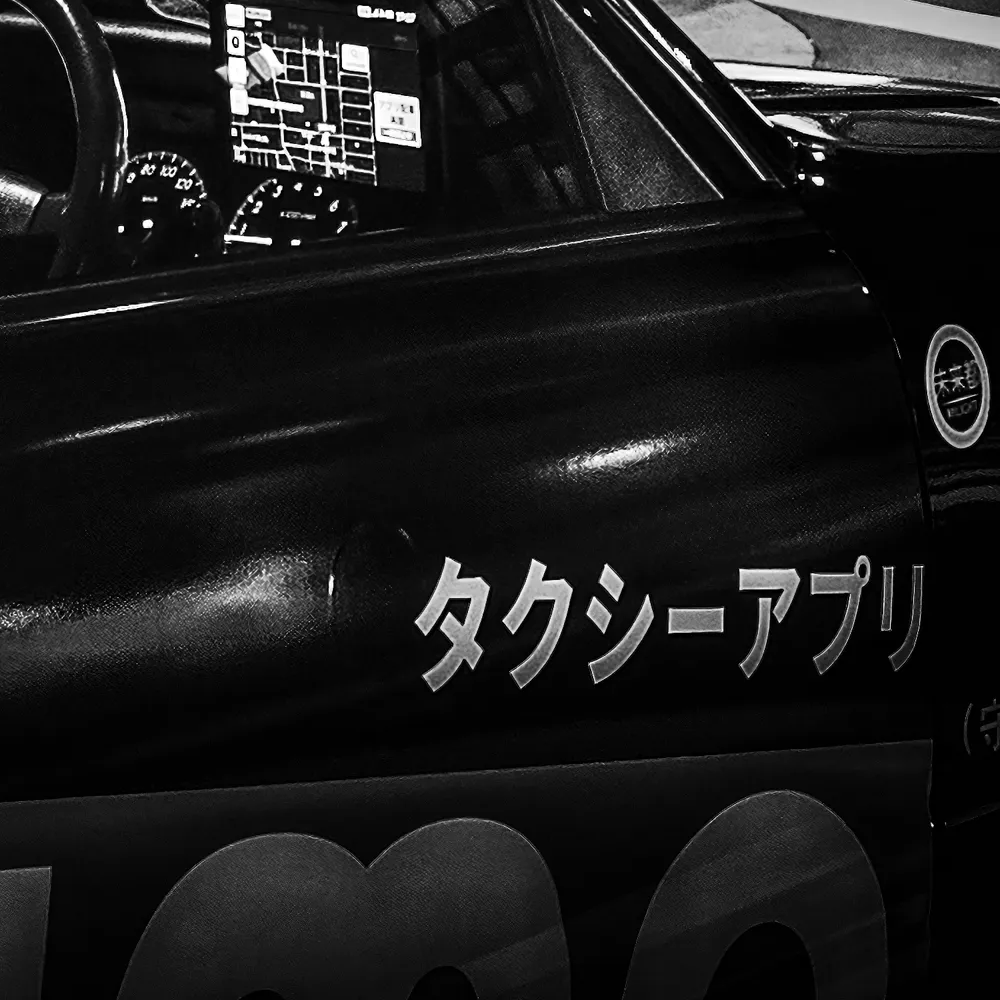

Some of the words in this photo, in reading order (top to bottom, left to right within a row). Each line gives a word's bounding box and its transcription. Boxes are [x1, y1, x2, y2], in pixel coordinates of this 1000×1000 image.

[160, 164, 178, 178] 100
[413, 554, 925, 692] タクシーアプリ
